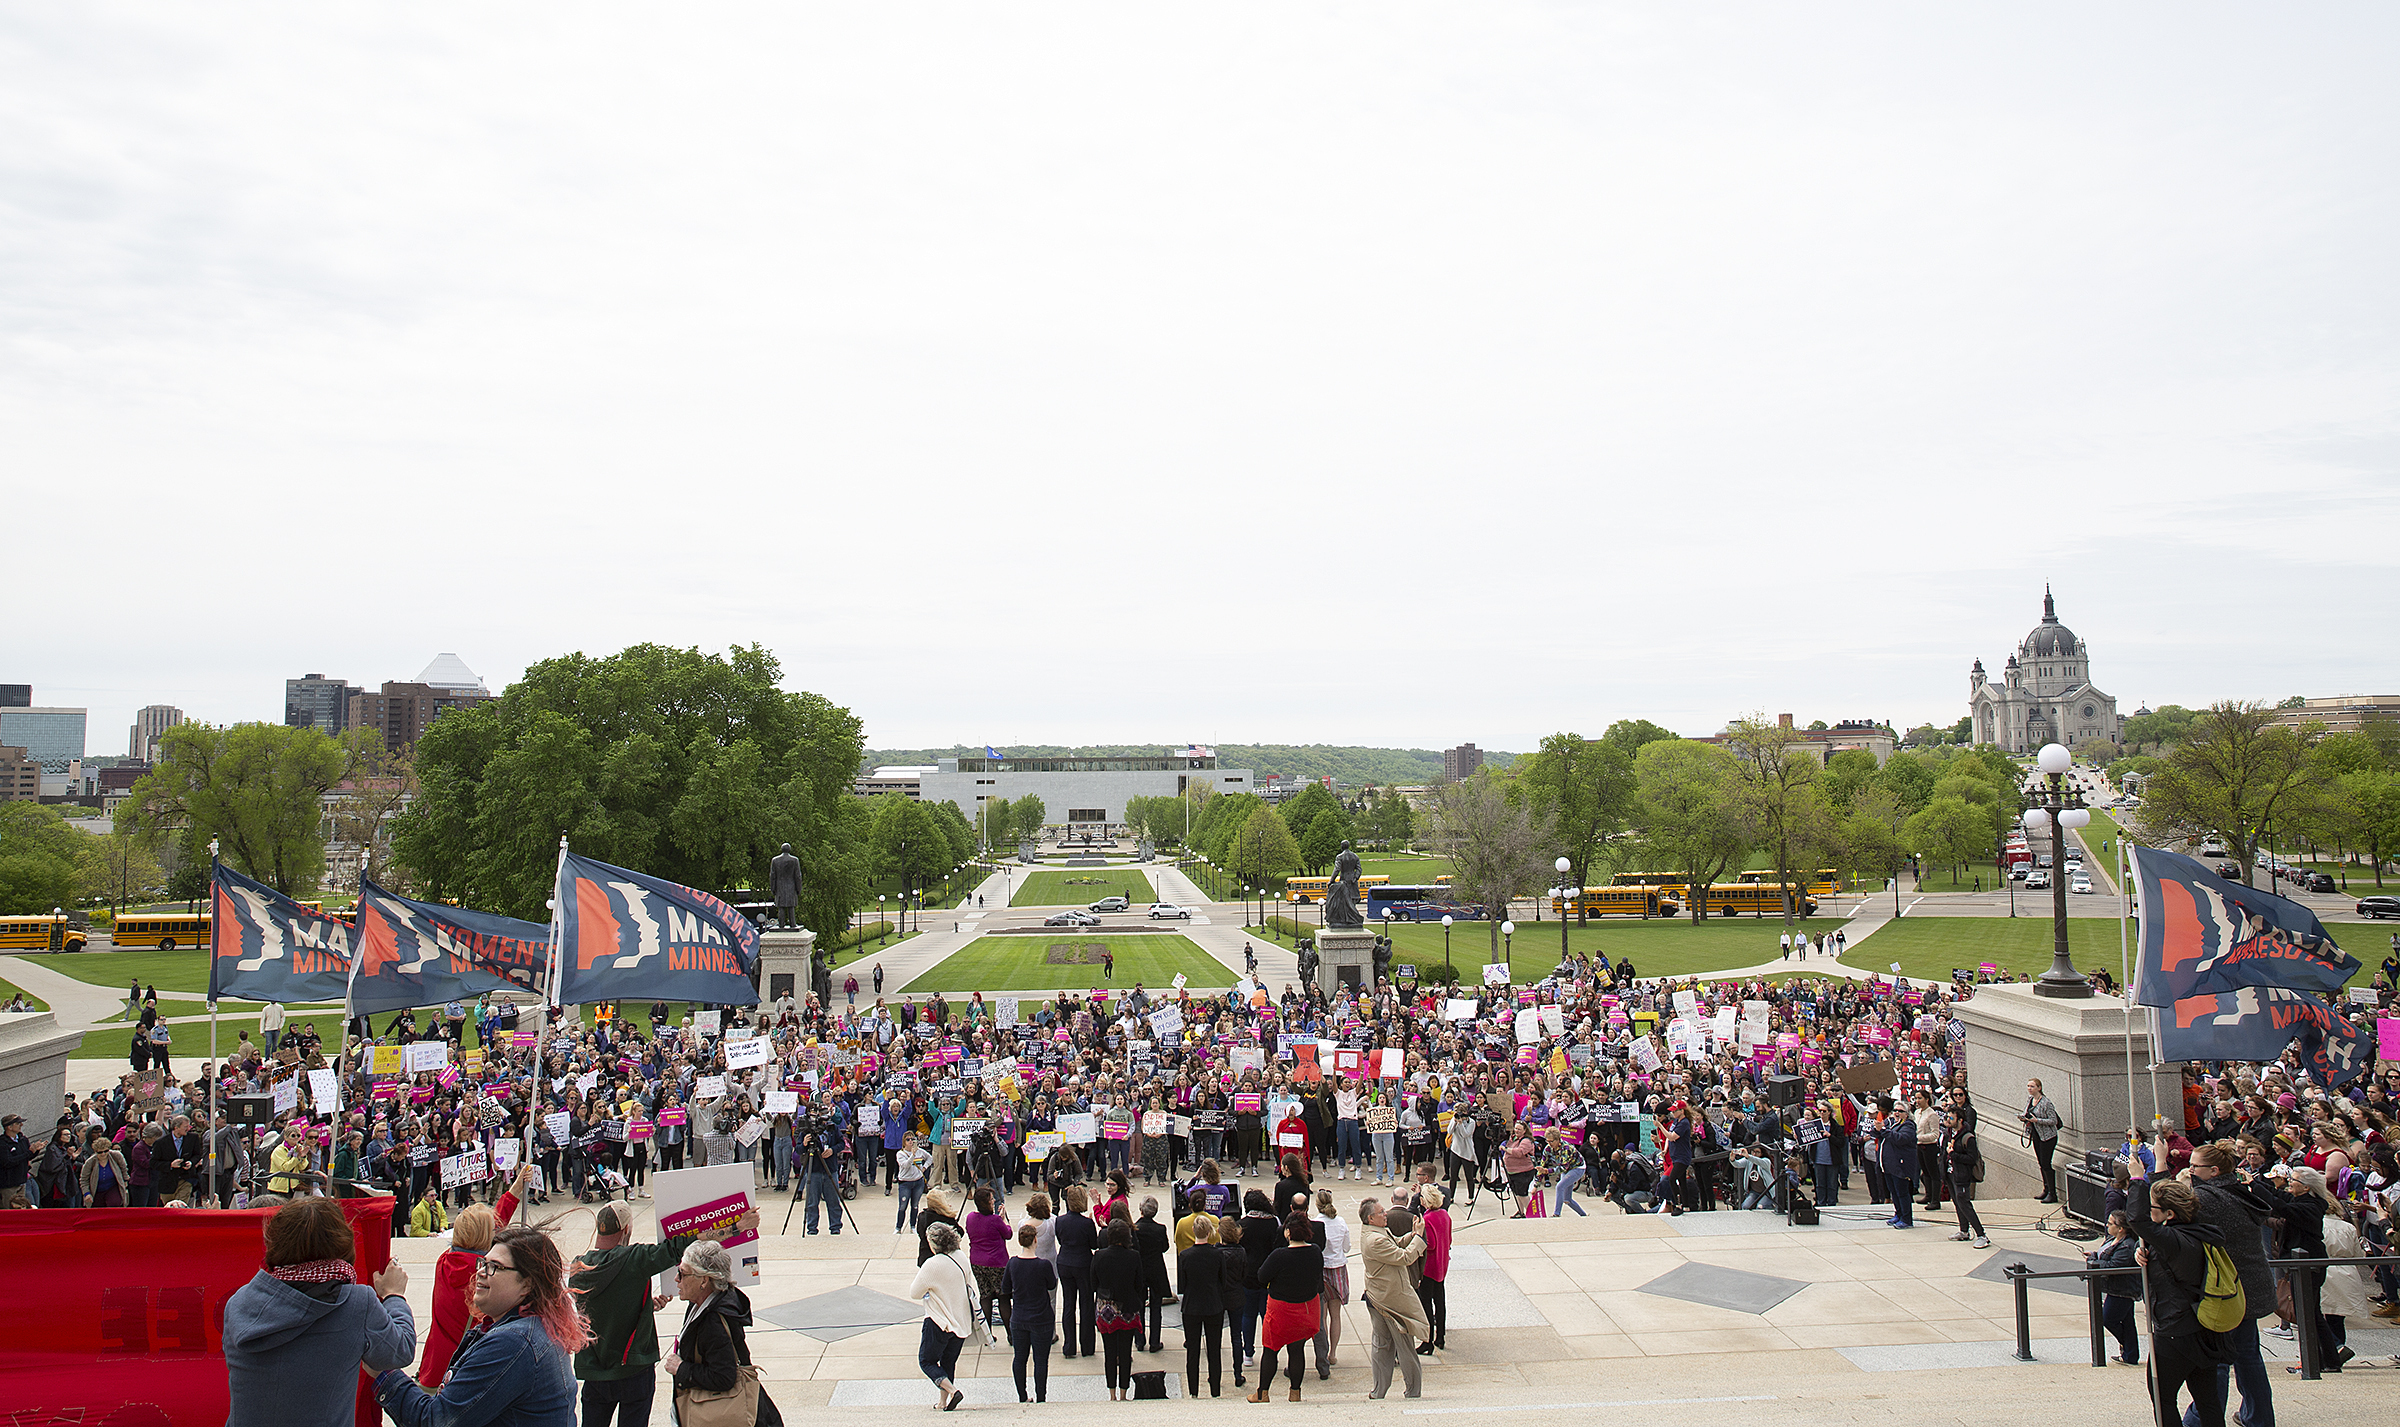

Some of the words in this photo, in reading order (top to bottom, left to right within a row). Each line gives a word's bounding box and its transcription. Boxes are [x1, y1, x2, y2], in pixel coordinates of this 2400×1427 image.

[1800, 1127, 1817, 1137] TRUST
[1801, 1133, 1823, 1143] WOMEN
[457, 1152, 486, 1169] FUTURE
[470, 1170, 487, 1181] RISK
[667, 1219, 692, 1232] KEEP
[694, 1202, 745, 1224] ABORTION
[713, 1213, 745, 1230] LEGA
